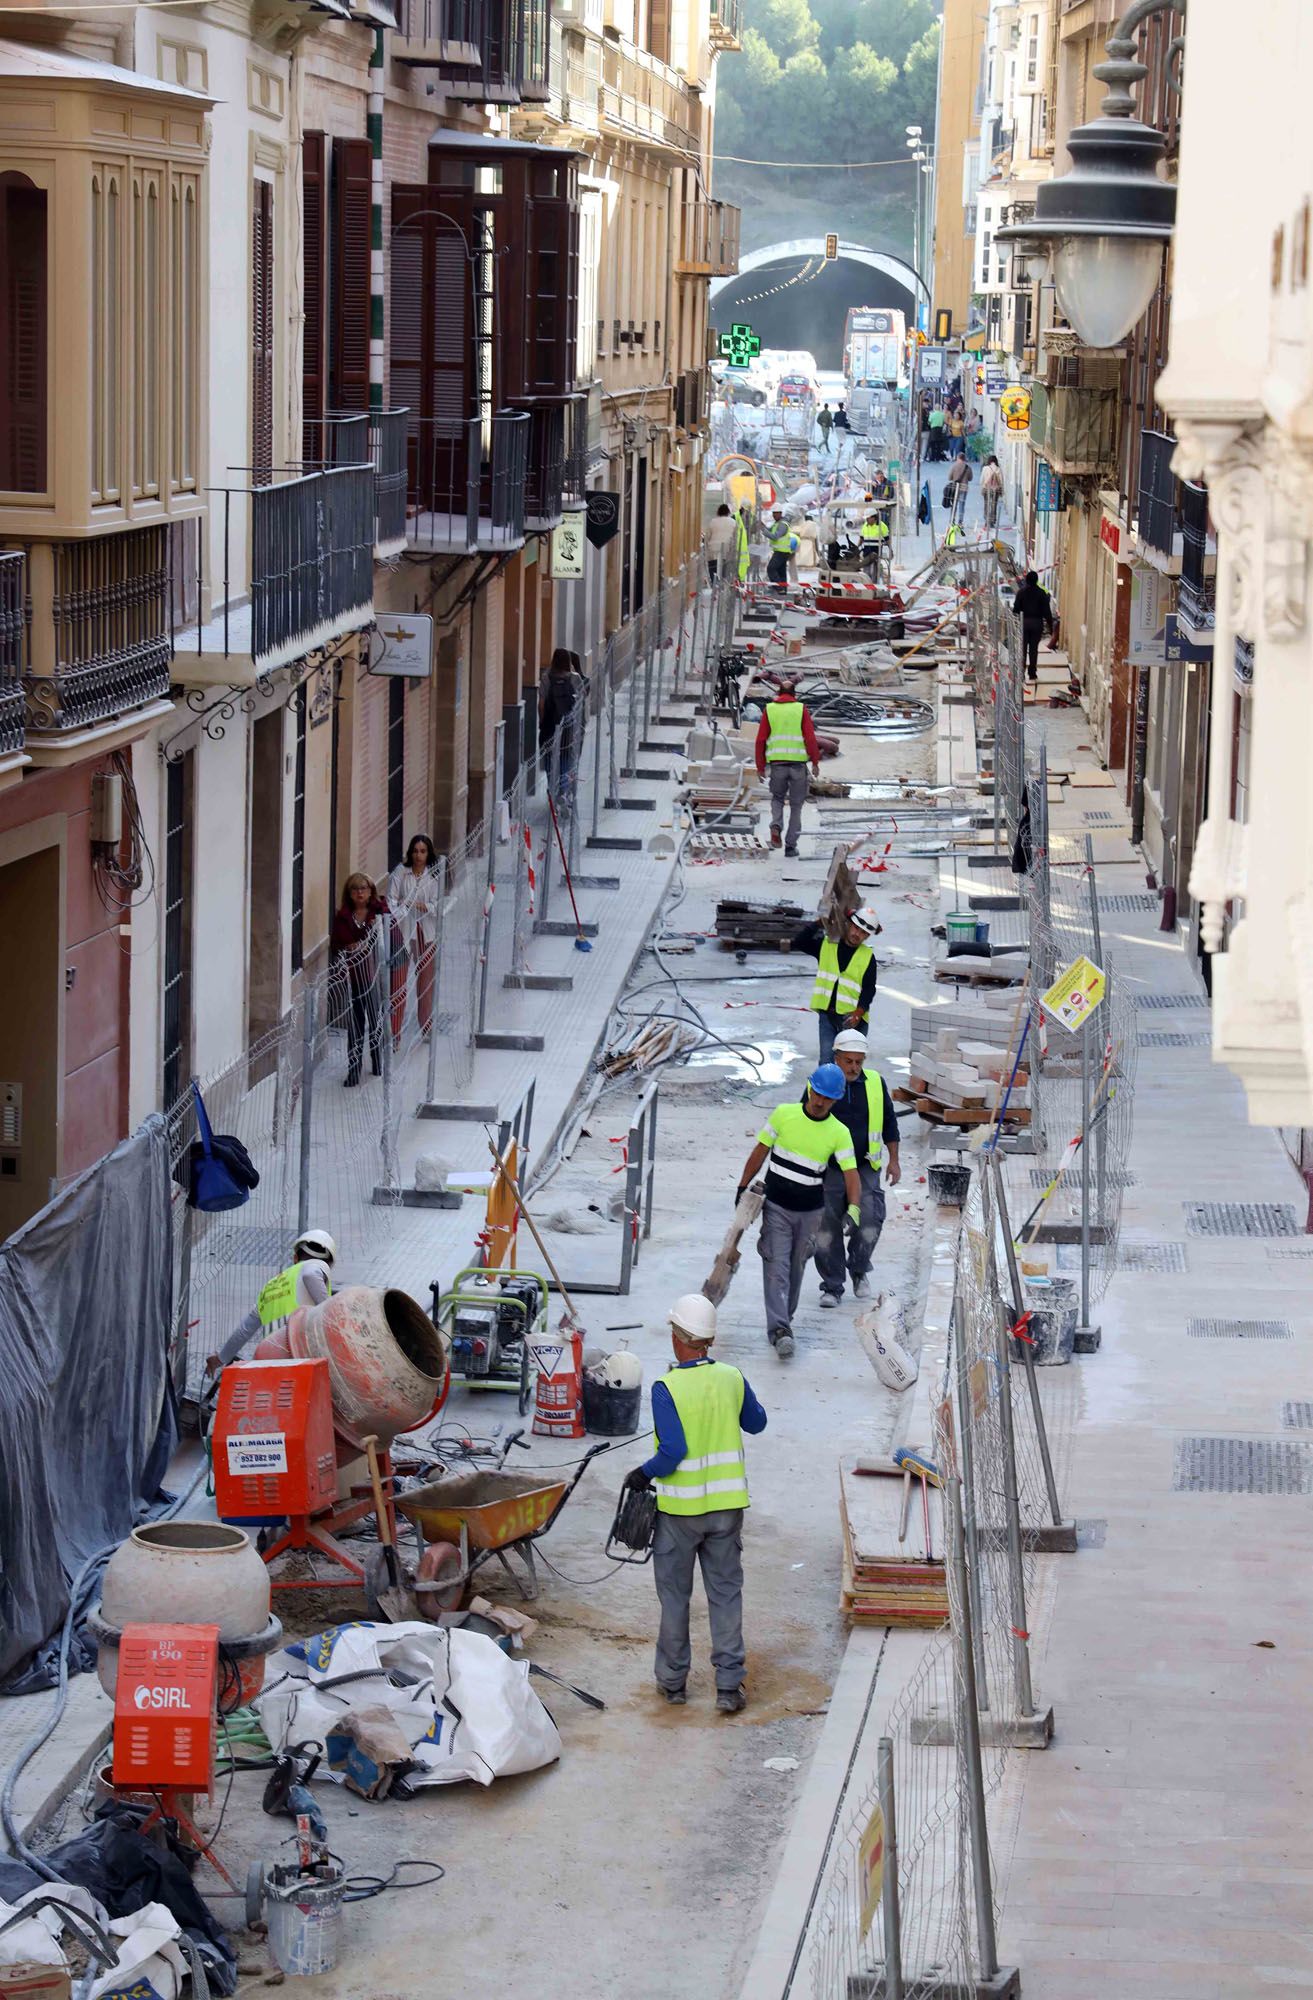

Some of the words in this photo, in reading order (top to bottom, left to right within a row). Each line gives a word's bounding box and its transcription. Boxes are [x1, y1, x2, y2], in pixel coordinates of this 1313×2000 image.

[534, 1346, 562, 1354] VICAT
[241, 1455, 253, 1463] 952
[268, 1453, 281, 1461] 900
[159, 1640, 176, 1650] BP
[151, 1650, 182, 1660] 190
[151, 1686, 191, 1708] SIRL
